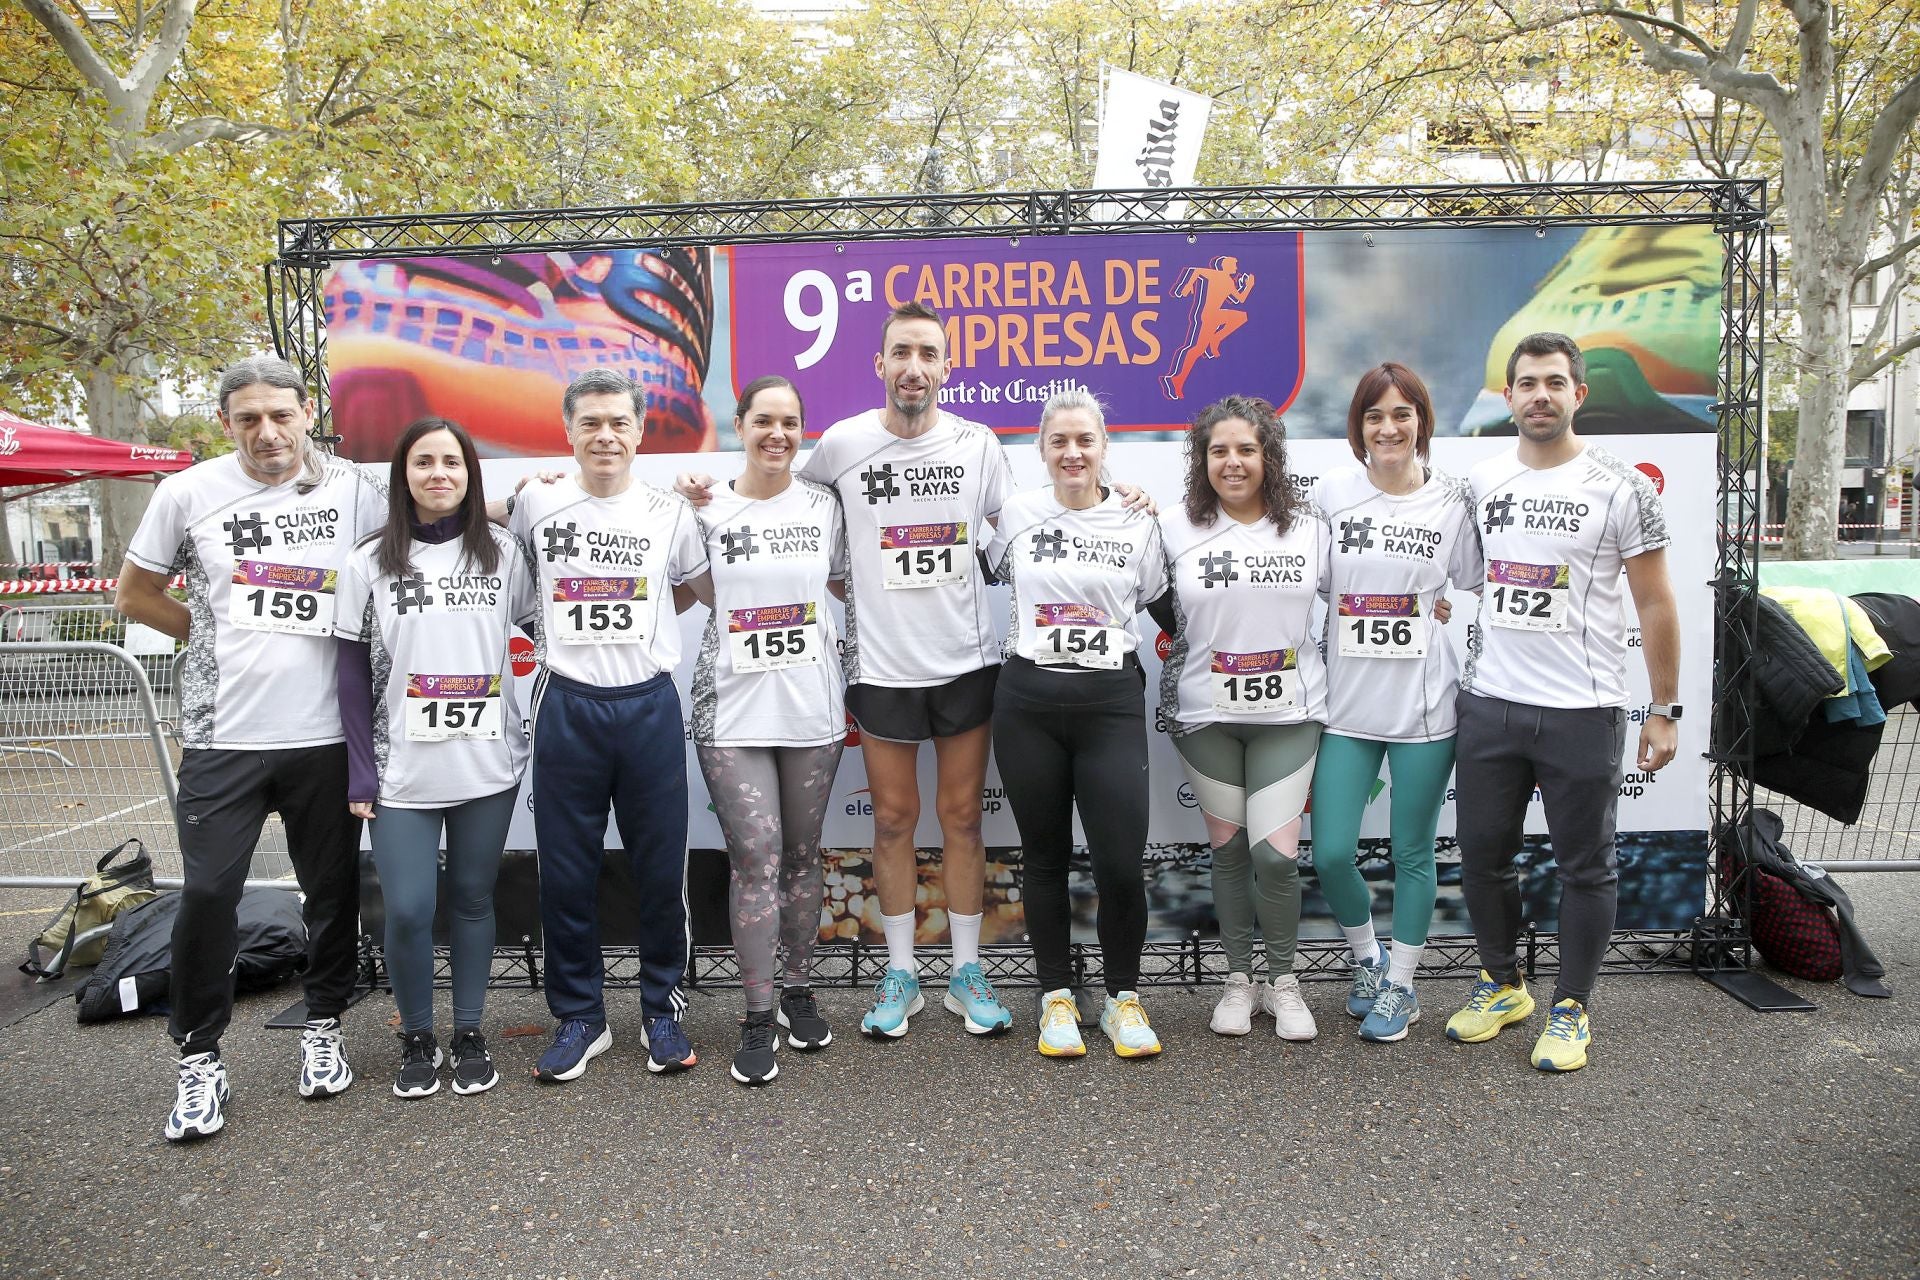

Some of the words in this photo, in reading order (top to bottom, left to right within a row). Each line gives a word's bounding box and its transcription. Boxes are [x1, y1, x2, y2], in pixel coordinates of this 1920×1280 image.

[884, 260, 1091, 310] CARRERA
[1104, 259, 1161, 305] DE
[979, 380, 1001, 404] de
[904, 466, 964, 481] CUATRO
[910, 481, 960, 497] RAYAS
[1522, 499, 1589, 517] CUATRO
[275, 508, 339, 529] CUATRO
[1524, 515, 1580, 532] RAYAS
[283, 525, 336, 545] RAYAS
[586, 532, 651, 552] CUATRO
[763, 526, 821, 541] CUATRO
[1381, 525, 1442, 545] CUATRO
[770, 540, 819, 554] RAYAS
[1073, 536, 1133, 554] CUATRO
[1384, 539, 1434, 559] RAYAS
[590, 548, 644, 566] RAYAS
[896, 548, 952, 576] 151
[1077, 551, 1126, 568] RAYAS
[1244, 555, 1305, 568] CUATRO
[437, 576, 502, 590] CUATRO
[1250, 570, 1302, 583] RAYAS
[247, 589, 318, 621] 159
[444, 592, 497, 606] RAYAS
[1493, 586, 1552, 618] 152
[568, 604, 633, 631] 153
[1047, 628, 1109, 655] 154
[1351, 619, 1412, 646] 156
[744, 629, 806, 659] 155
[1224, 674, 1283, 702] 158
[422, 702, 486, 728] 157
